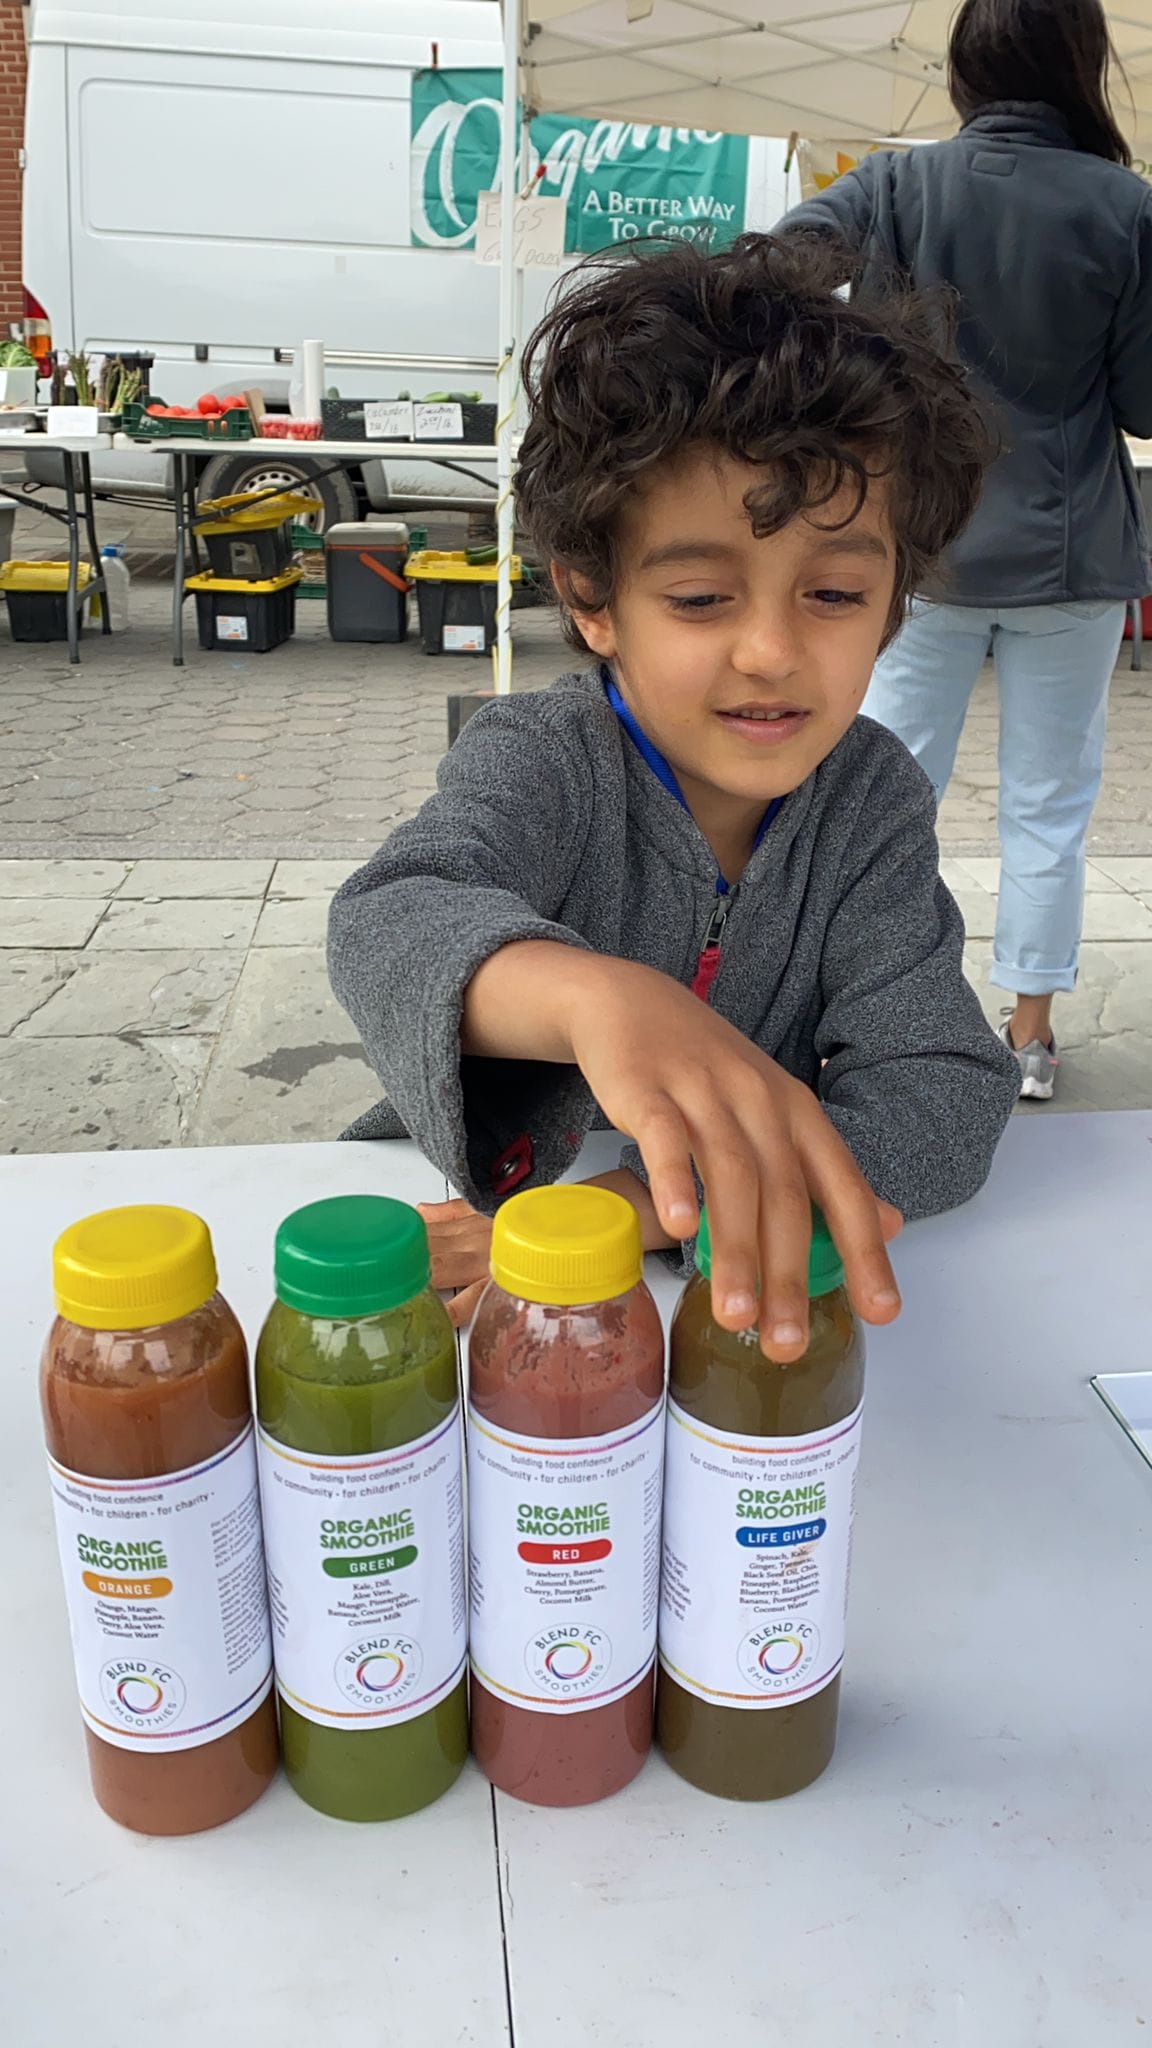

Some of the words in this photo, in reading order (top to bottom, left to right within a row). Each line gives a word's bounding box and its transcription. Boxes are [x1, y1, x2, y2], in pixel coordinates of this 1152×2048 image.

[582, 190, 602, 212] A
[484, 202, 546, 233] EGS
[487, 1458, 531, 1483] community
[540, 1474, 555, 1484] for
[558, 1473, 598, 1484] children
[606, 1467, 618, 1478] for
[621, 1452, 646, 1472] charity
[511, 1454, 543, 1469] building
[545, 1460, 565, 1470] food
[567, 1455, 613, 1470] confidence
[690, 1453, 700, 1464] for
[702, 1460, 753, 1482] community
[763, 1473, 777, 1481] for
[780, 1468, 817, 1481] children
[824, 1459, 836, 1471] for
[732, 1455, 766, 1468] building
[768, 1458, 788, 1467] food
[790, 1449, 831, 1467] confidence
[310, 1472, 344, 1484] building
[346, 1473, 367, 1483] food
[369, 1461, 415, 1480] confidence
[284, 1479, 333, 1498] community
[342, 1489, 357, 1498] for
[360, 1481, 400, 1497] children
[408, 1473, 421, 1484] for
[738, 1481, 825, 1504] ORGANIC
[91, 1507, 103, 1517] for
[106, 1508, 147, 1519] children
[157, 1506, 172, 1516] for
[175, 1492, 209, 1512] charity
[94, 1494, 112, 1504] food
[114, 1493, 164, 1504] confidence
[735, 1496, 827, 1520] SMOOTHIE
[320, 1508, 412, 1534] ORGANIC
[517, 1502, 608, 1521] ORGANIC
[320, 1522, 415, 1550] SMOOTHIE
[517, 1516, 610, 1536] SMOOTHIE
[748, 1532, 778, 1544] LIFE
[782, 1525, 820, 1542] GIVER
[77, 1533, 163, 1556] ORGANIC
[552, 1549, 580, 1560] RED
[78, 1547, 168, 1571] SMOOTHIE
[350, 1557, 395, 1573] GREEN
[766, 1570, 784, 1578] Seed
[98, 1581, 152, 1595] ORANGE
[353, 1592, 371, 1600] Aloe
[575, 1595, 592, 1603] Milk
[361, 1606, 394, 1616] Coconut
[787, 1601, 808, 1610] Water
[348, 1617, 381, 1627] Coconut
[383, 1612, 401, 1621] Milk
[535, 1627, 580, 1649] BLEND
[583, 1630, 601, 1646] FC
[749, 1622, 793, 1646] BLEND
[797, 1624, 813, 1639] FC
[345, 1638, 390, 1664] BLEND
[394, 1640, 413, 1654] FC
[106, 1662, 147, 1680] BLEND
[152, 1667, 172, 1683] FC
[534, 1665, 604, 1692] SMOOTHIES
[747, 1656, 812, 1687] SMOOTHIES
[346, 1672, 415, 1704] SMOOTHIES
[109, 1699, 177, 1727] SMOOTHIES
